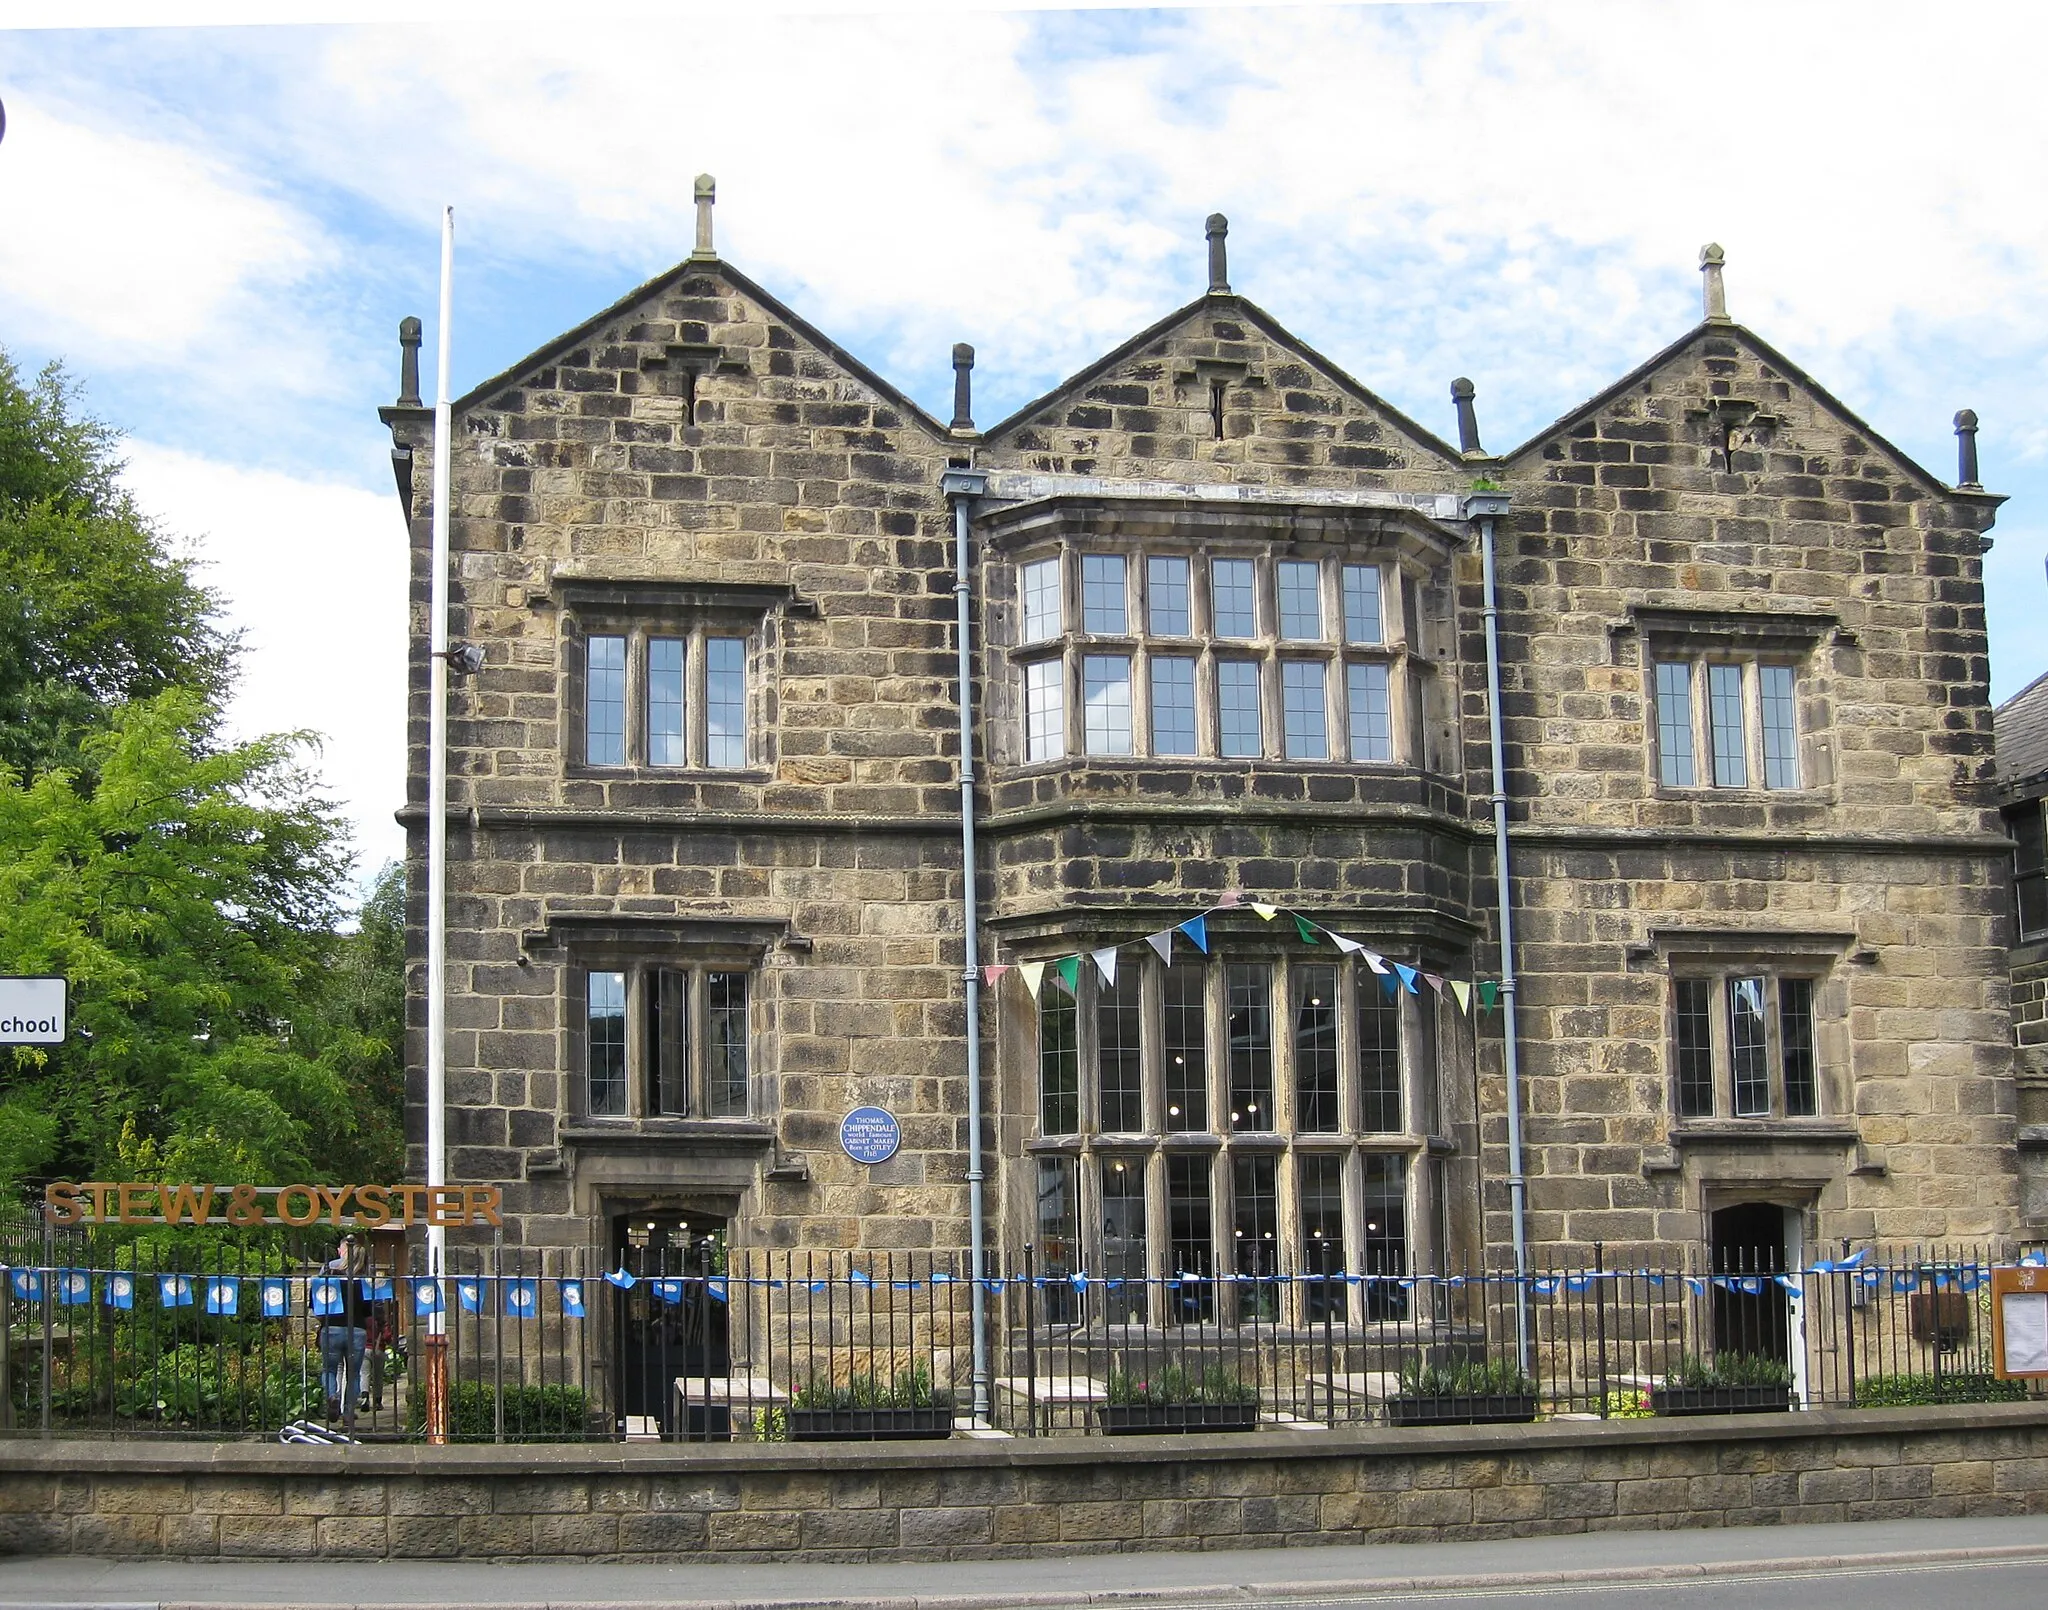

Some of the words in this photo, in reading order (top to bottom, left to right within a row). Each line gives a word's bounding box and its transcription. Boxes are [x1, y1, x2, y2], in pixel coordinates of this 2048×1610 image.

[0, 1016, 57, 1033] chool
[843, 1124, 896, 1132] CHIPPENDALE
[46, 1181, 215, 1225] STEW
[225, 1183, 268, 1226] &
[276, 1183, 502, 1227] OYSTER
